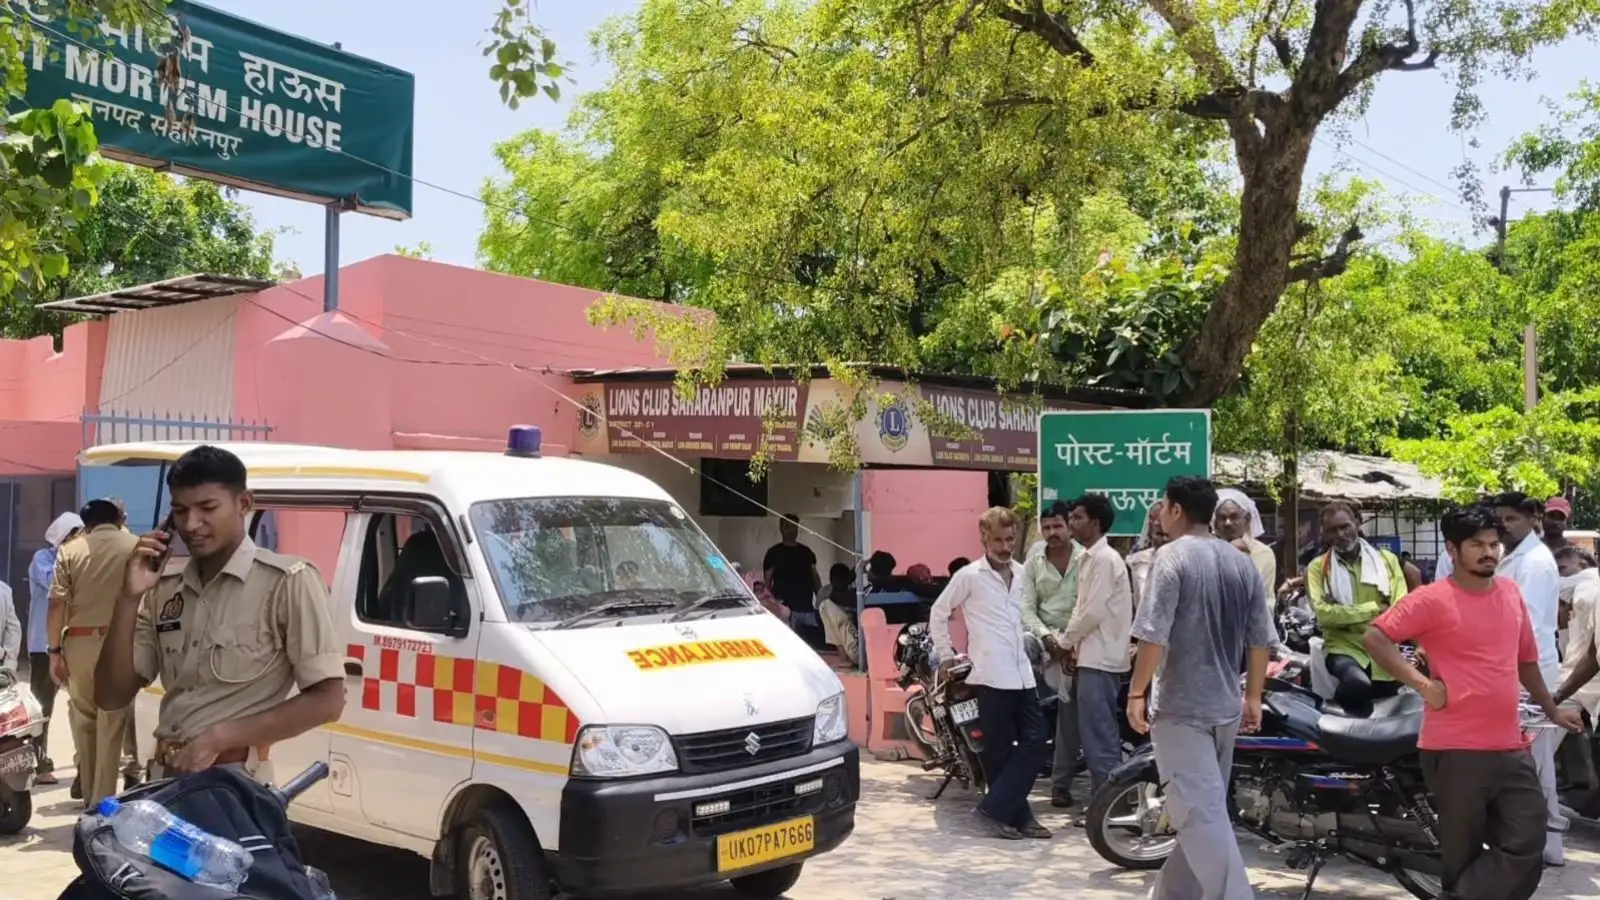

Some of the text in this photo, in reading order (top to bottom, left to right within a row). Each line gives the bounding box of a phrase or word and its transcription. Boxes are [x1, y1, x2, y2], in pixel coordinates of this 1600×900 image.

[238, 50, 346, 115] हाऊस
[239, 95, 342, 152] HOUSE
[609, 386, 798, 417] LIONS CLUB SAHARANPUR MAYUR
[967, 398, 997, 430] CLUB
[1054, 432, 1192, 466] पोस्ट-मॉर्टम
[728, 822, 813, 860] UK07PA7666
